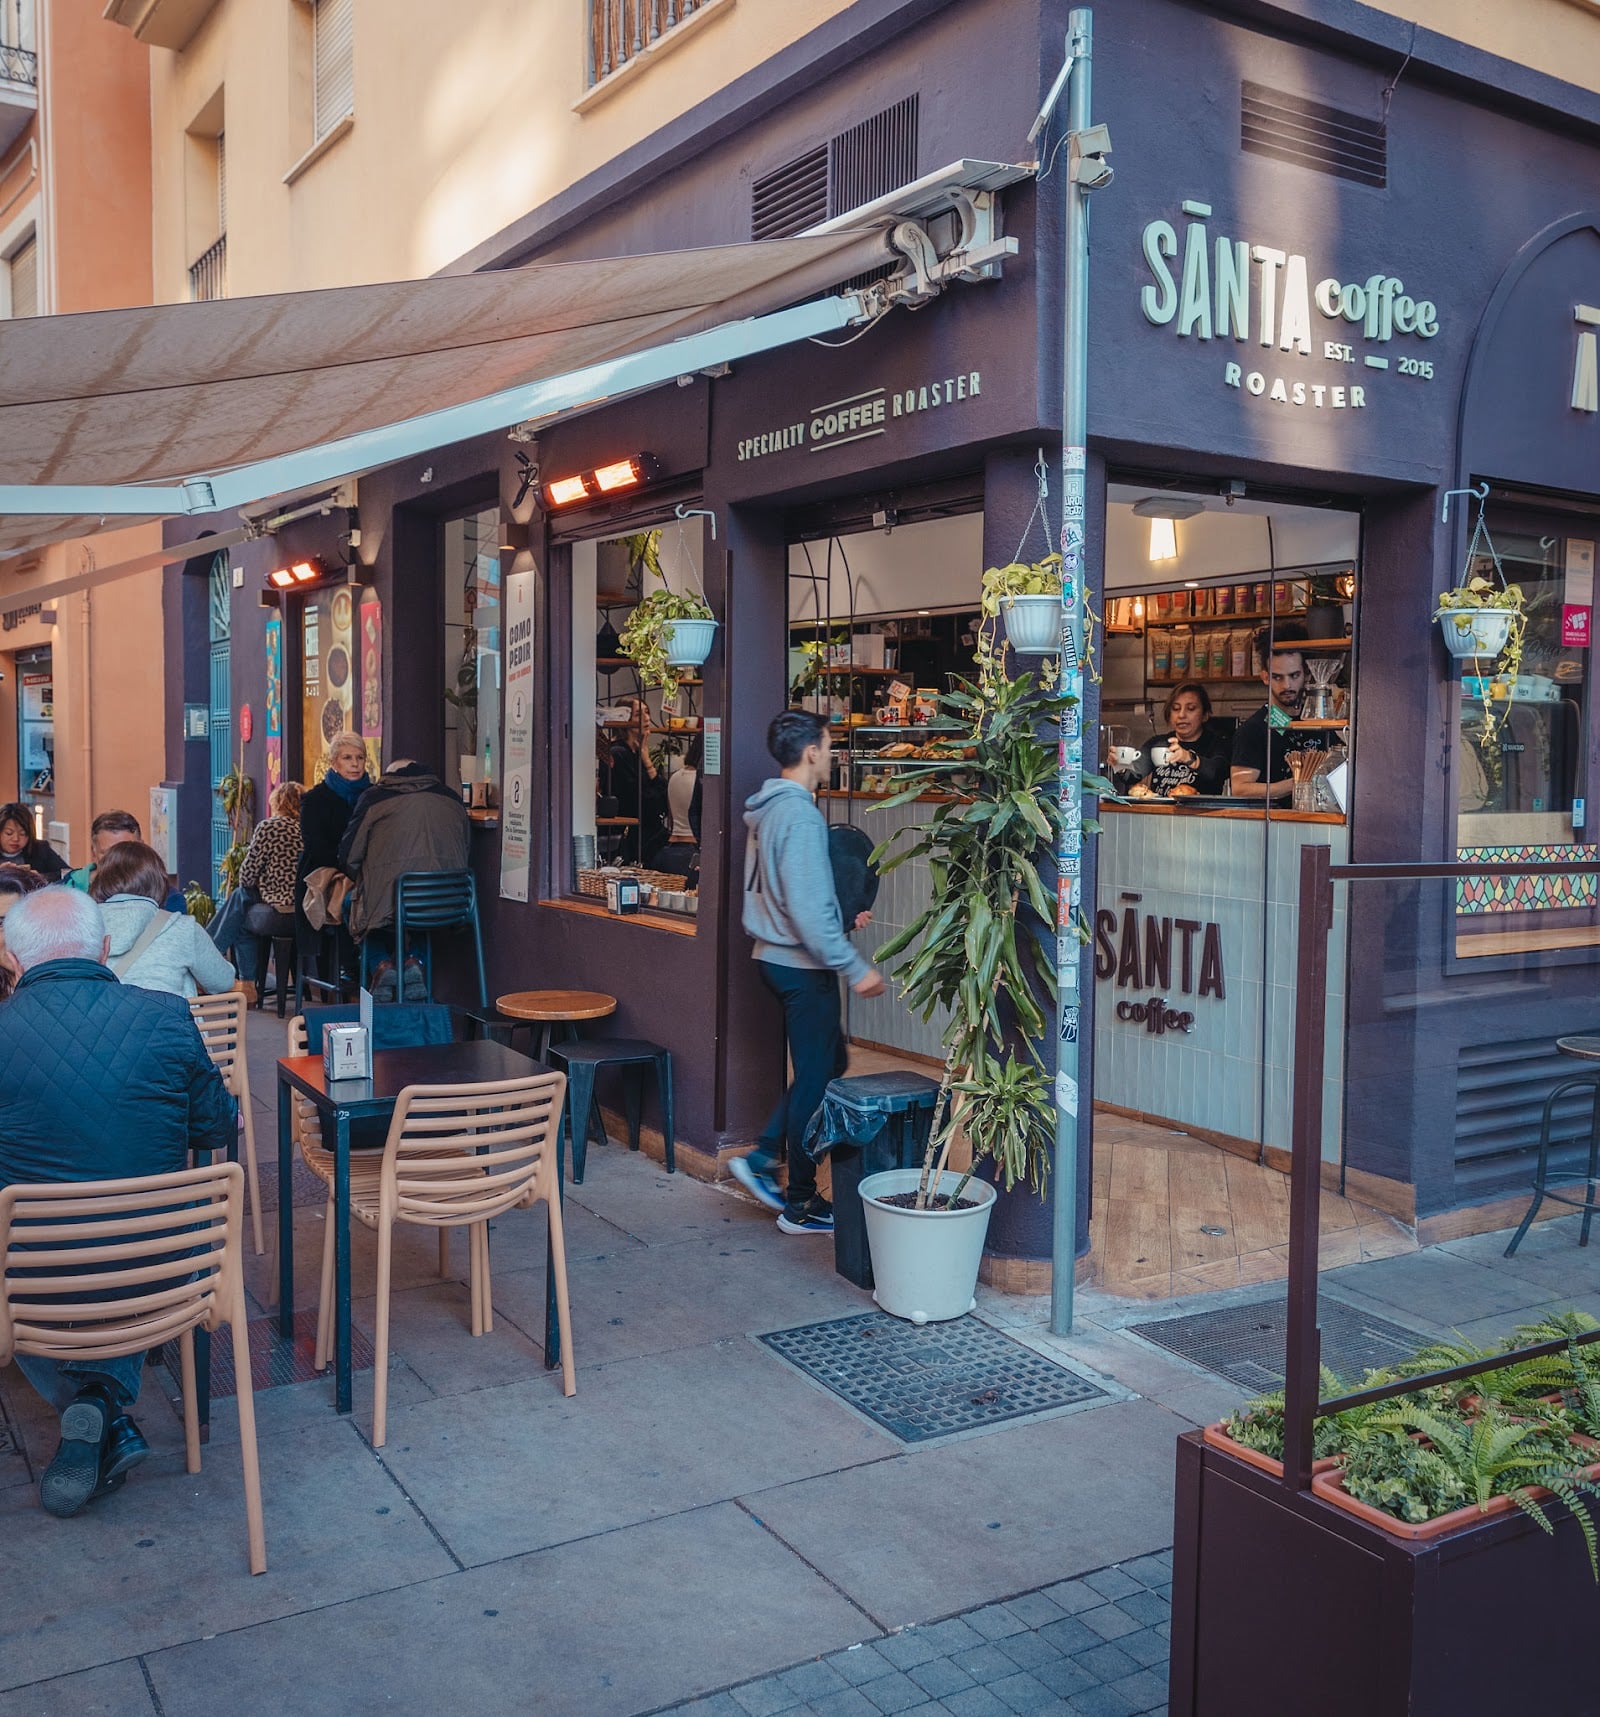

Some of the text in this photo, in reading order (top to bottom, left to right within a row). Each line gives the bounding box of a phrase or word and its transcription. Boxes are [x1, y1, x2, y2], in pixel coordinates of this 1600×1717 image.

[1315, 274, 1439, 341] coffee
[1324, 341, 1434, 380] EST. 2015
[1225, 361, 1367, 409] ROASTER
[738, 371, 982, 462] SPECIALTY COFFEE ROASTER
[510, 617, 531, 646] COMO
[509, 641, 531, 669] PEDIR
[514, 780, 519, 803] 2
[1116, 997, 1194, 1035] coffee
